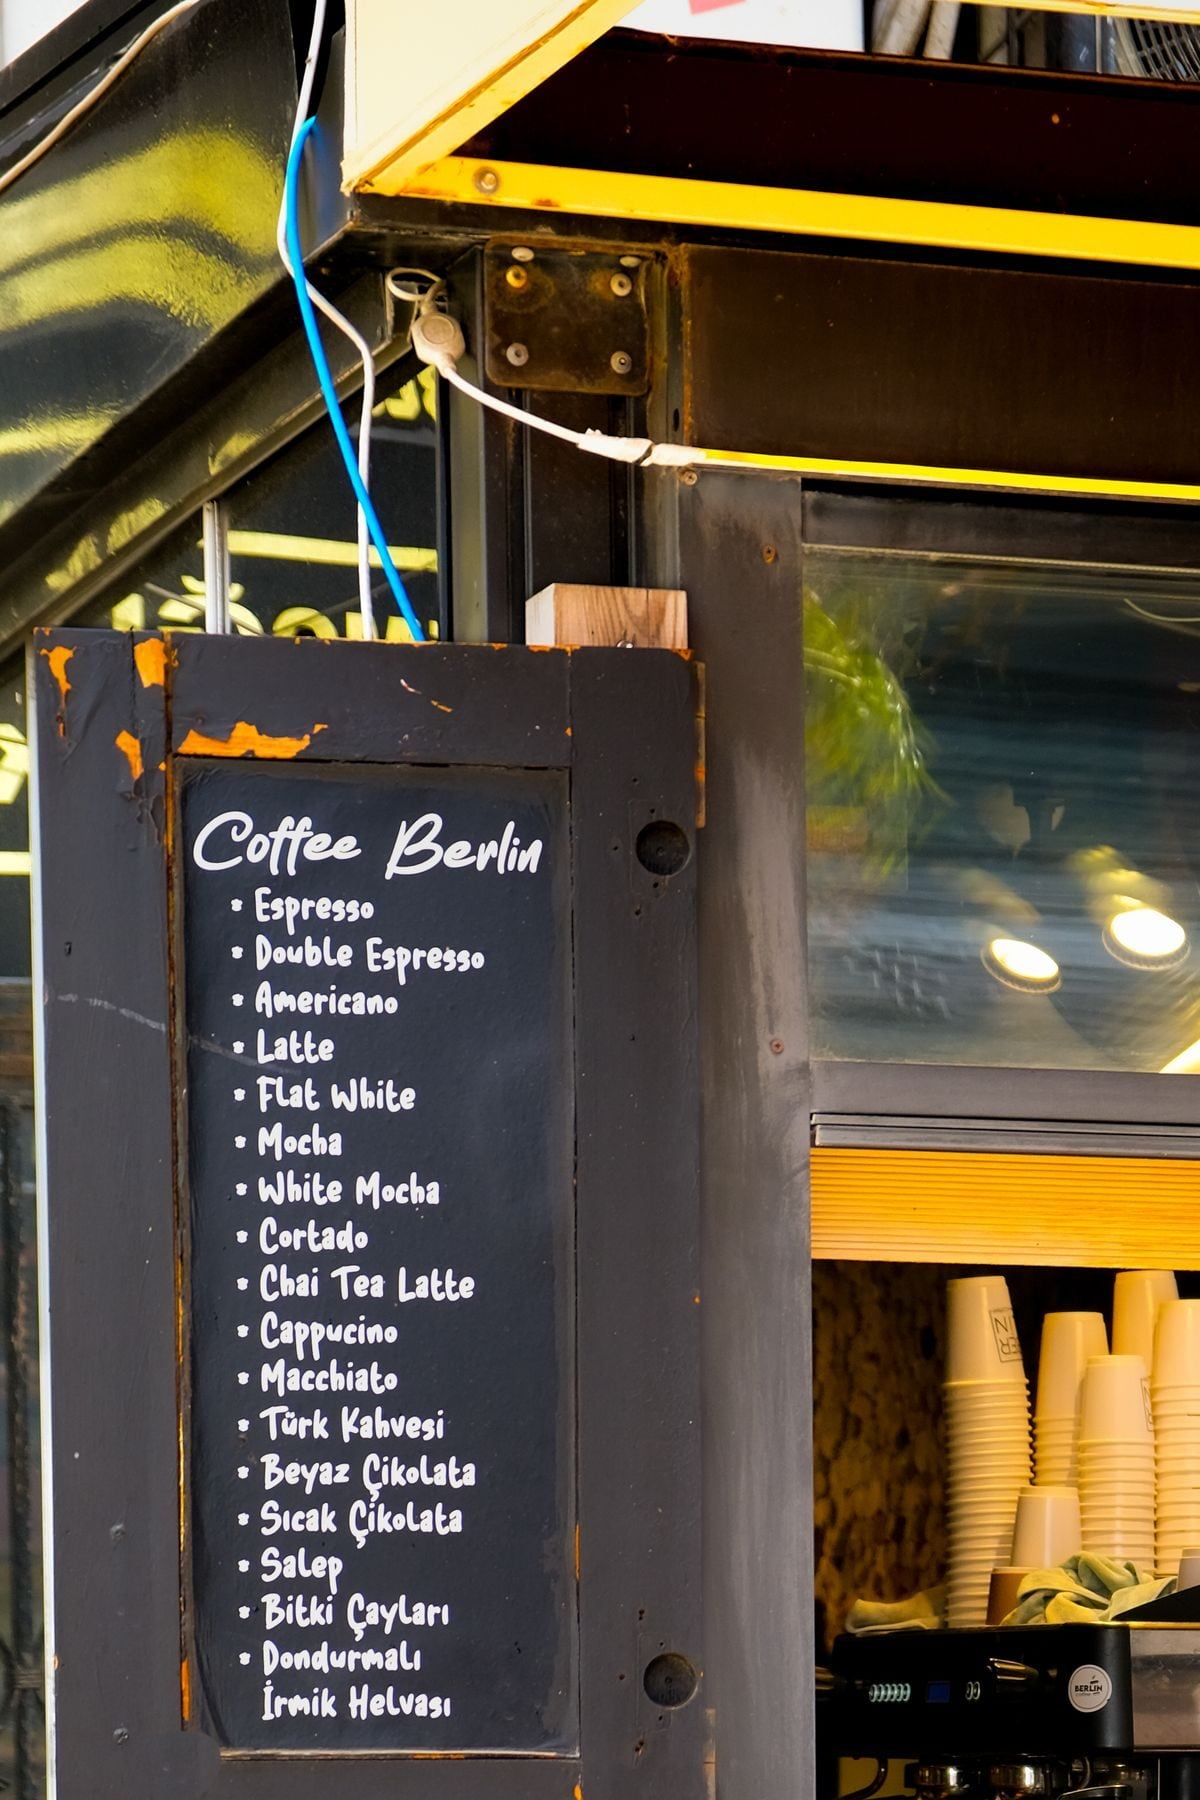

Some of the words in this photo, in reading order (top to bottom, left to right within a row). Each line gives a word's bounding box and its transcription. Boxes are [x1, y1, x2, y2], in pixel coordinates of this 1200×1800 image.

[194, 811, 361, 876] Coffee
[385, 813, 542, 880] Berlin
[255, 887, 374, 935] Espresso
[256, 935, 352, 970] Double
[366, 937, 484, 985] Espresso
[256, 981, 398, 1018] Americano
[257, 1029, 334, 1064] Latte
[257, 1076, 320, 1112] Flat
[331, 1077, 415, 1112] White
[258, 1122, 341, 1160] Mocha
[259, 1170, 342, 1205] White
[356, 1172, 439, 1209] Mocha
[260, 1217, 368, 1254] Cortado
[260, 1264, 318, 1301] Chai
[331, 1265, 385, 1300] Tea
[399, 1267, 474, 1302] Latte
[261, 1311, 397, 1360] Cappucino
[261, 1359, 397, 1397] Macchiato
[260, 1406, 329, 1440] Türk
[342, 1406, 443, 1442] Kahvesi
[260, 1454, 349, 1494] Beyaz
[363, 1453, 475, 1502] Çikolata
[261, 1500, 337, 1535] Sıcak
[349, 1500, 462, 1549] Çikolata
[261, 1547, 342, 1595] Salep
[261, 1593, 333, 1629] Bitki
[347, 1593, 448, 1641] Çayları
[263, 1640, 420, 1676] Dondurmalı
[262, 1680, 336, 1720] İrmik
[349, 1684, 450, 1720] Helvası
[1074, 1684, 1102, 1692] BERLIN
